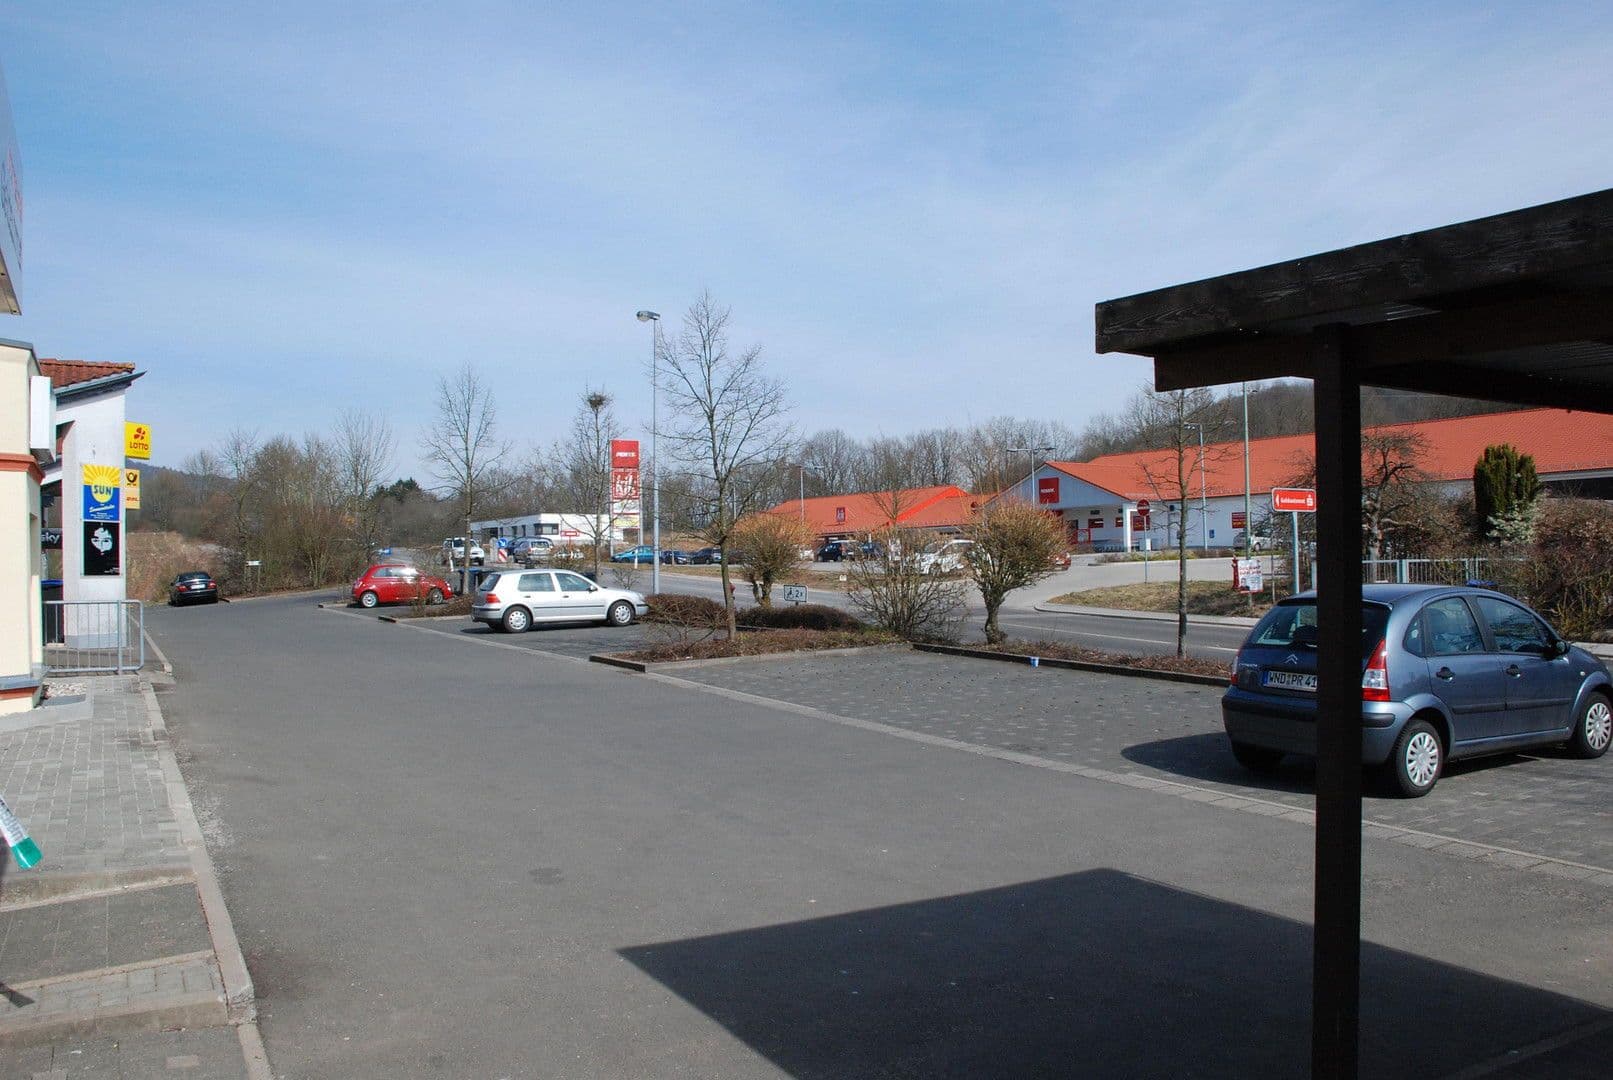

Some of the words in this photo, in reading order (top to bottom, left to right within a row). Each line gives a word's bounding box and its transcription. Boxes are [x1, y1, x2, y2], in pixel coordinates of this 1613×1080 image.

[130, 441, 149, 451] LOTTO
[93, 485, 112, 496] SUN
[1291, 674, 1304, 686] PR
